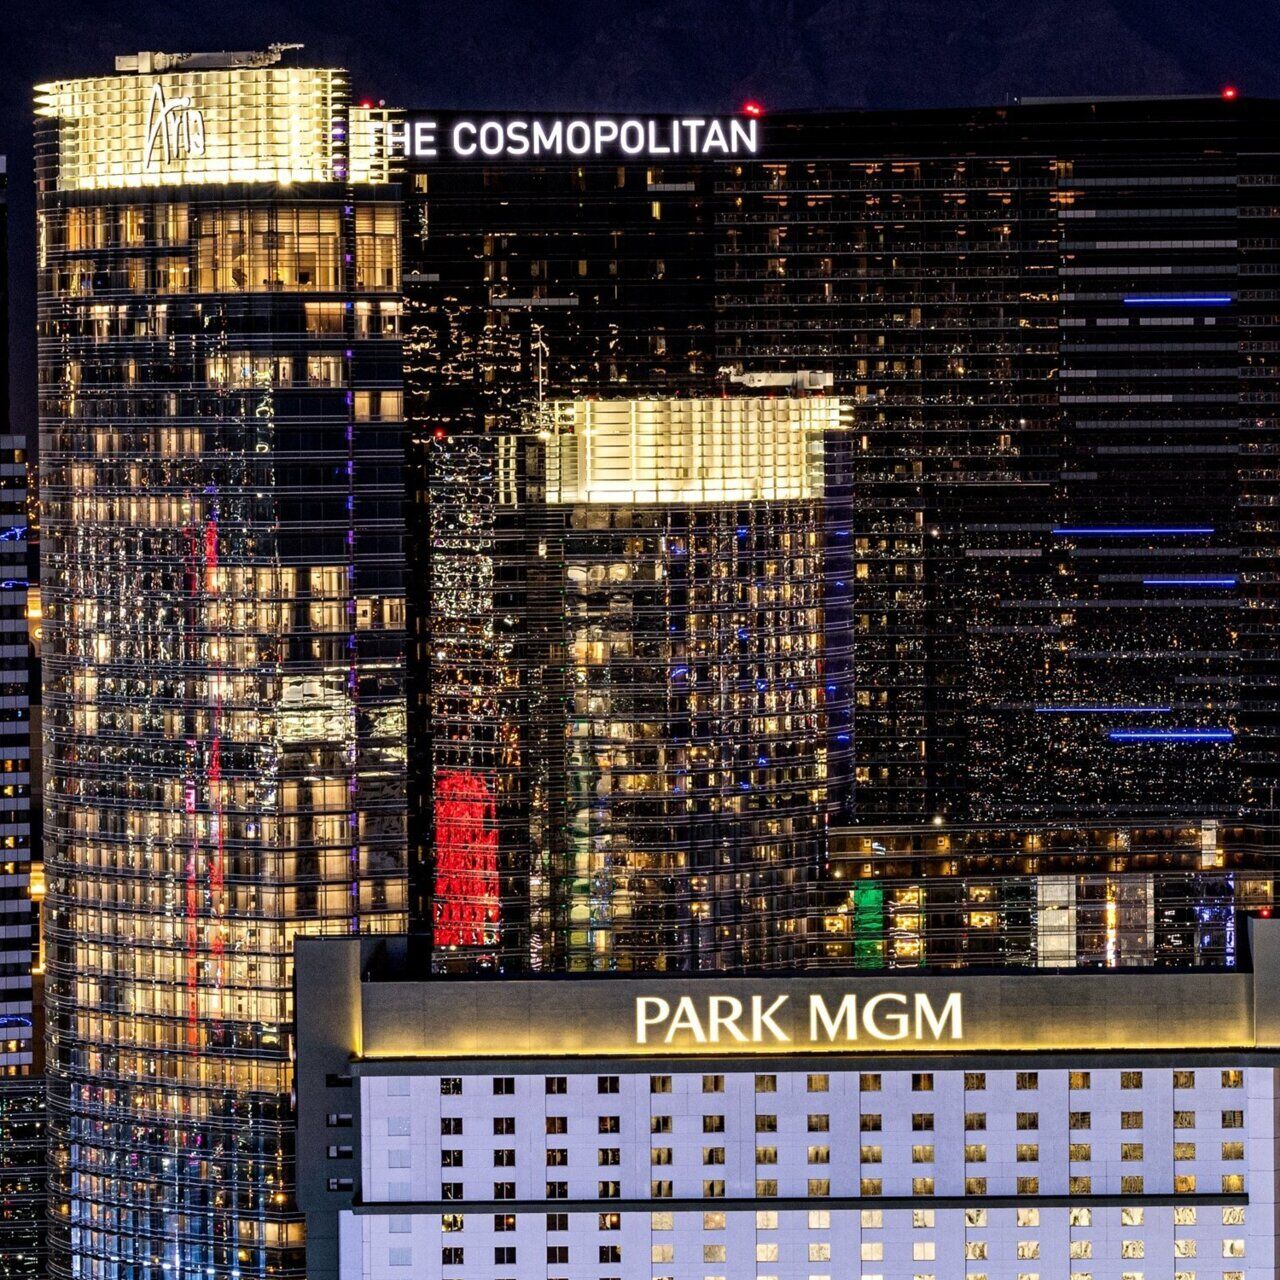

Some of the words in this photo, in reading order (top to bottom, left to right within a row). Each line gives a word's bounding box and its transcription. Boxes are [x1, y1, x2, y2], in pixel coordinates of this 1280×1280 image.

[452, 119, 757, 156] COSMOPOLITAN
[635, 995, 792, 1043] PARK
[809, 992, 964, 1042] MGM
